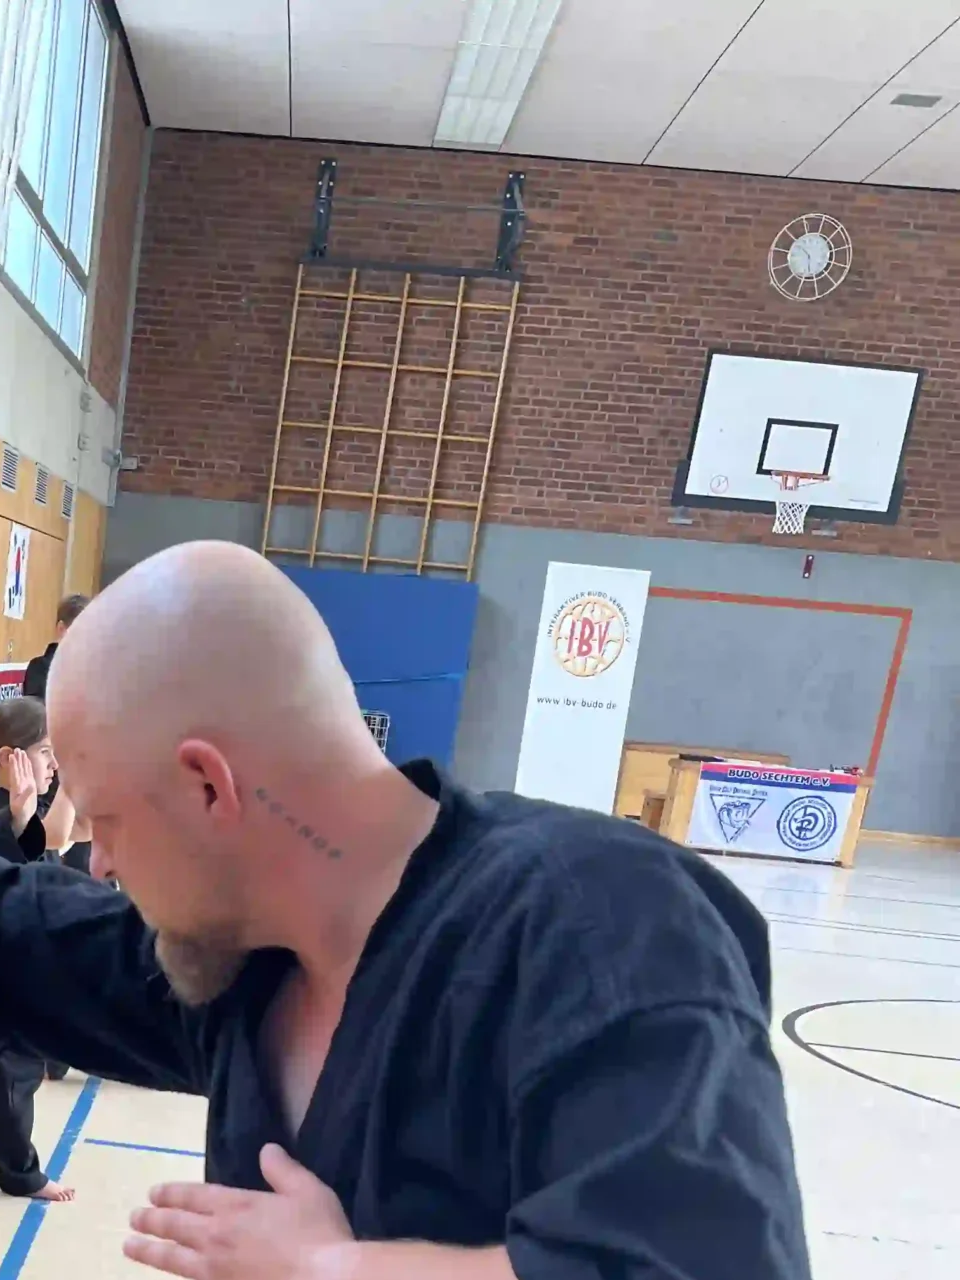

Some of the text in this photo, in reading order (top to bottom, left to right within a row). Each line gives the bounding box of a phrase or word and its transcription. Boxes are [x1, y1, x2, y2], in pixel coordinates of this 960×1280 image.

[587, 591, 607, 599] BUDO
[567, 617, 610, 657] IBV
[537, 696, 617, 710] wwwibv-budode
[728, 769, 759, 779] BUDO
[761, 772, 810, 785] SECHTEM
